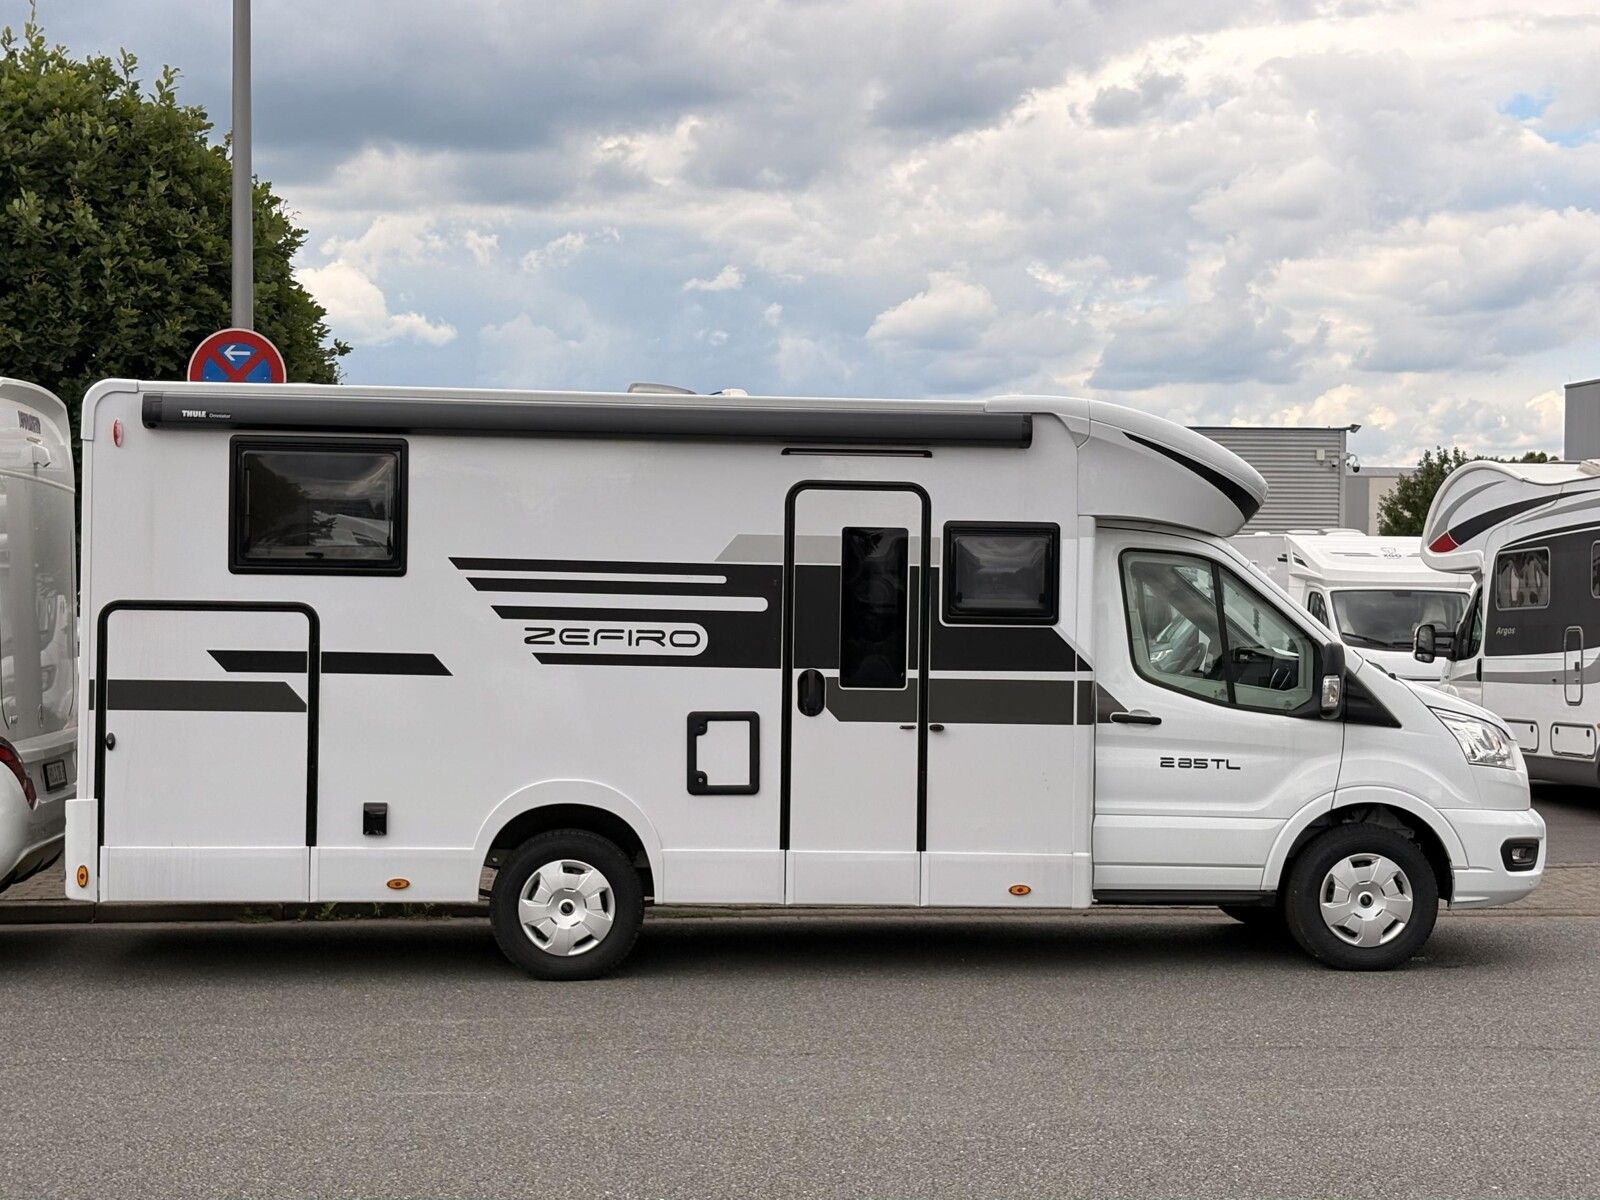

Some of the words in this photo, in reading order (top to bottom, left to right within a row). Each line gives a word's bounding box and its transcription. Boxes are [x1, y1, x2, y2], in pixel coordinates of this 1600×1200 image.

[181, 410, 206, 418] THULE
[1495, 626, 1516, 637] Argos
[524, 627, 700, 648] ZEFIRO
